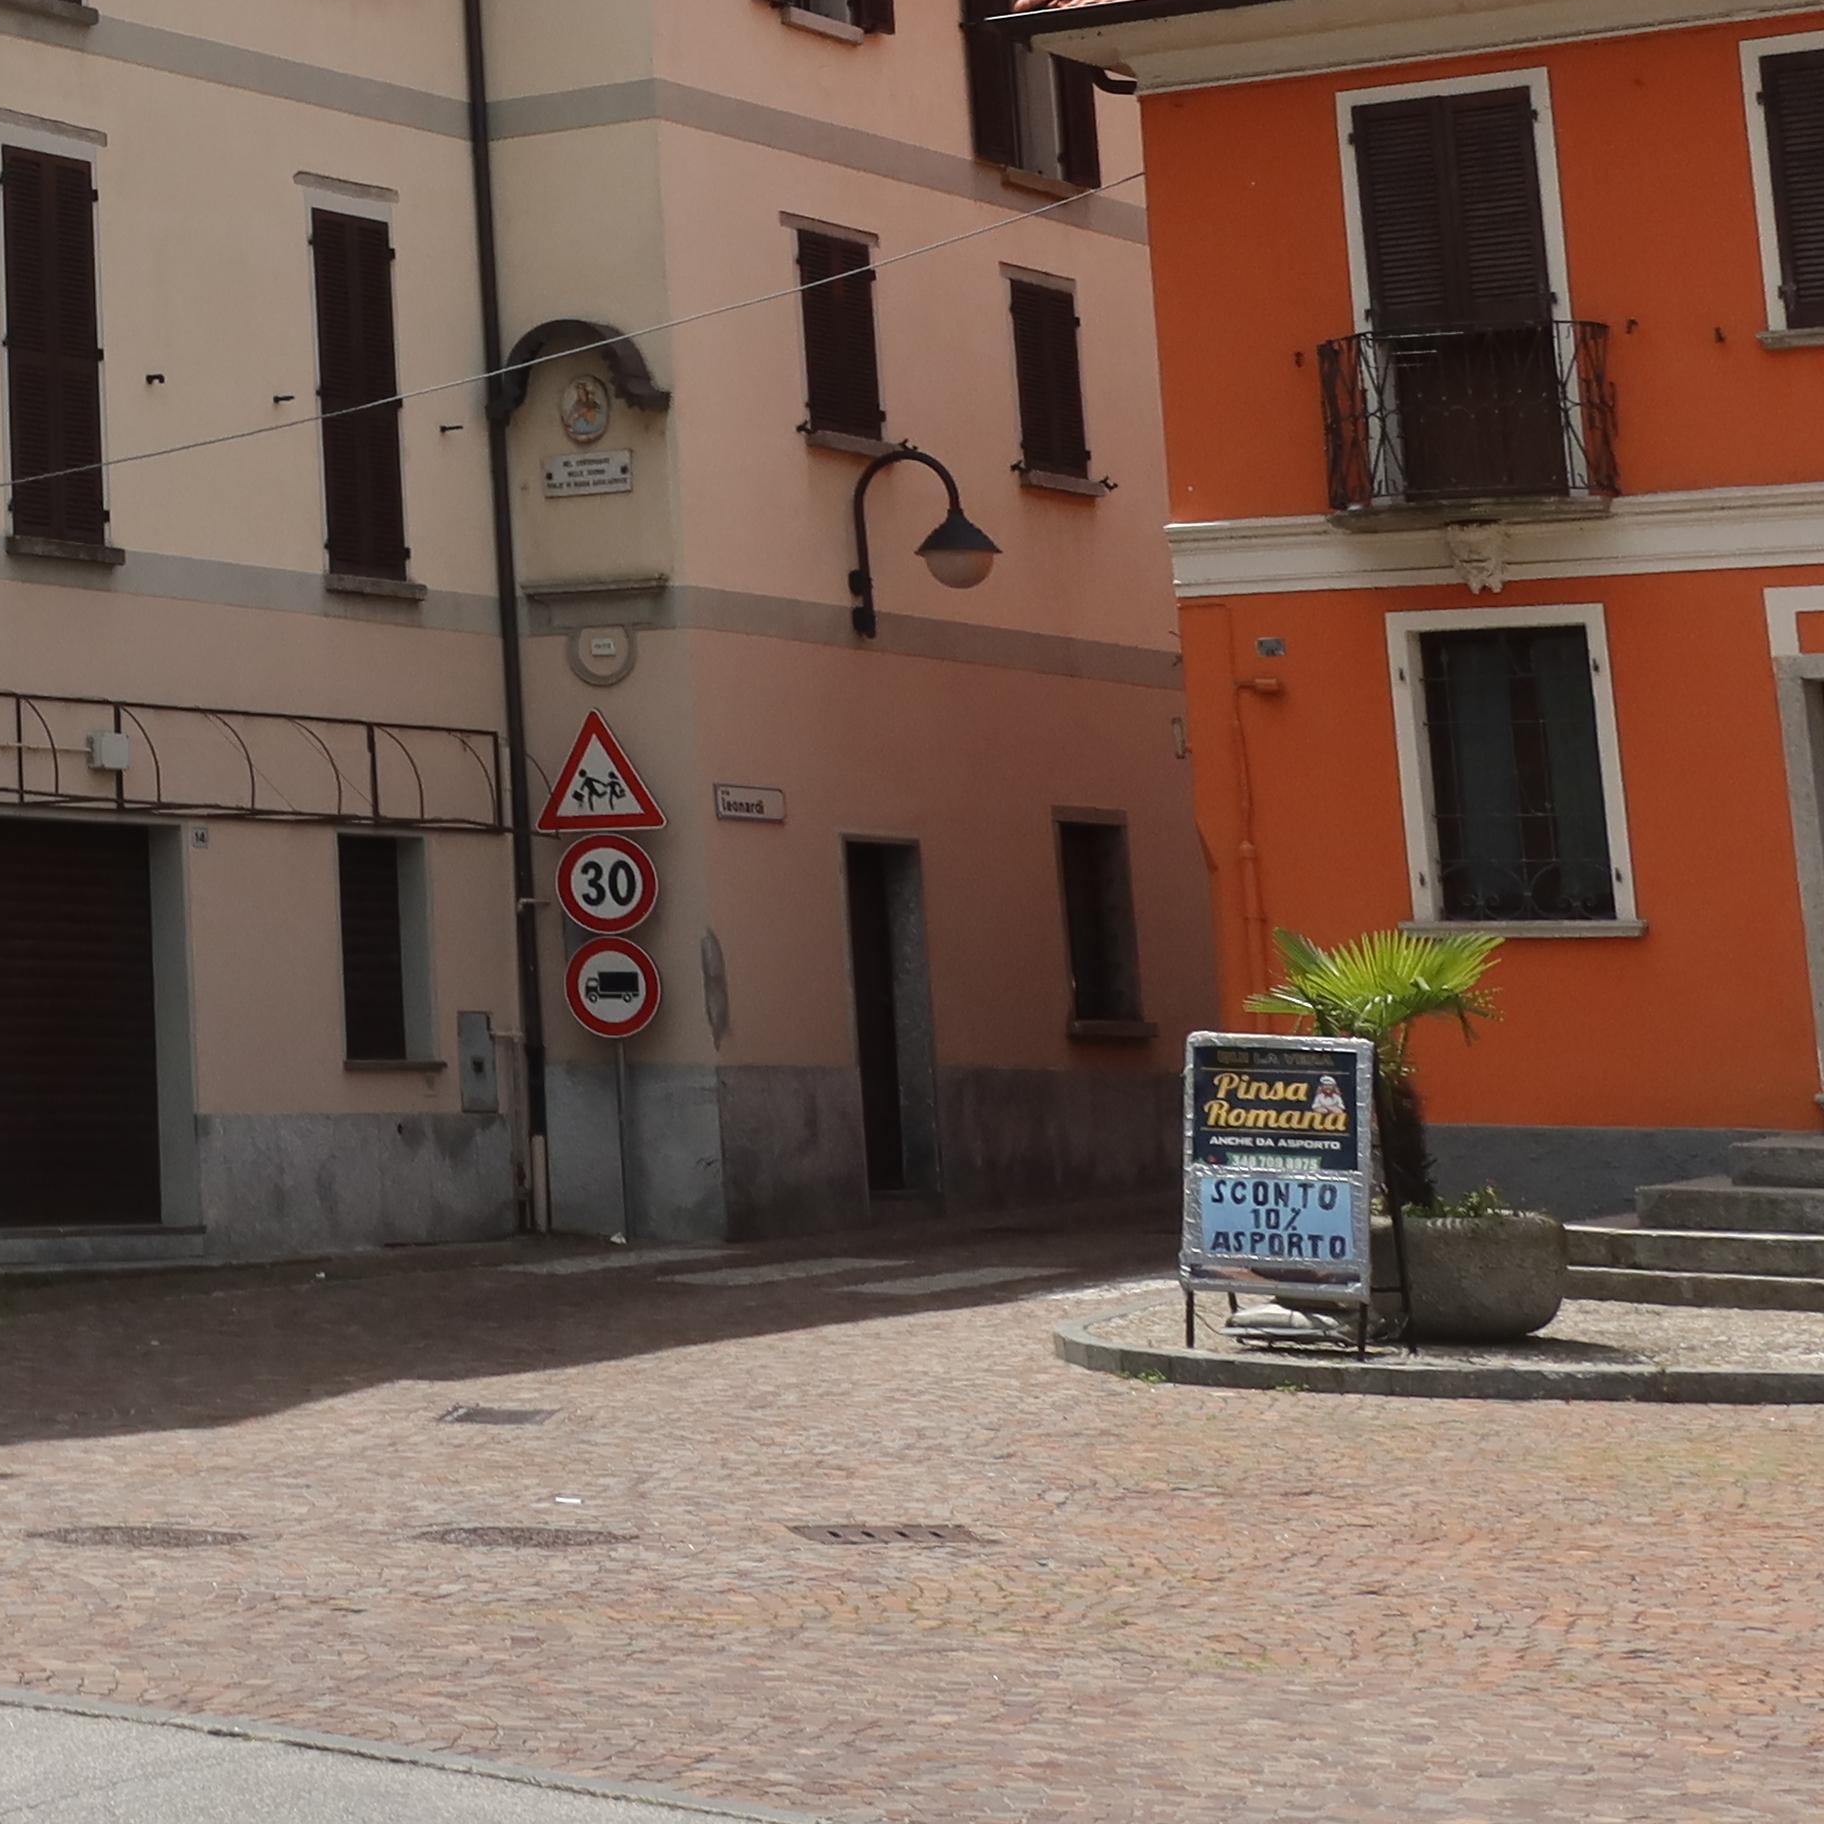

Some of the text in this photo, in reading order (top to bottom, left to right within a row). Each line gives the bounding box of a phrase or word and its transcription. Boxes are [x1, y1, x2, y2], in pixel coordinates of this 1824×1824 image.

[581, 859, 637, 907] 30
[1213, 1072, 1309, 1101] Pinsa
[1203, 1099, 1348, 1131] Romana
[1209, 1135, 1341, 1150] ANCHE DA ASPORTO
[1211, 1179, 1338, 1211] SCONTO
[1250, 1207, 1302, 1232] 10%
[1210, 1231, 1346, 1259] ASPORTO
